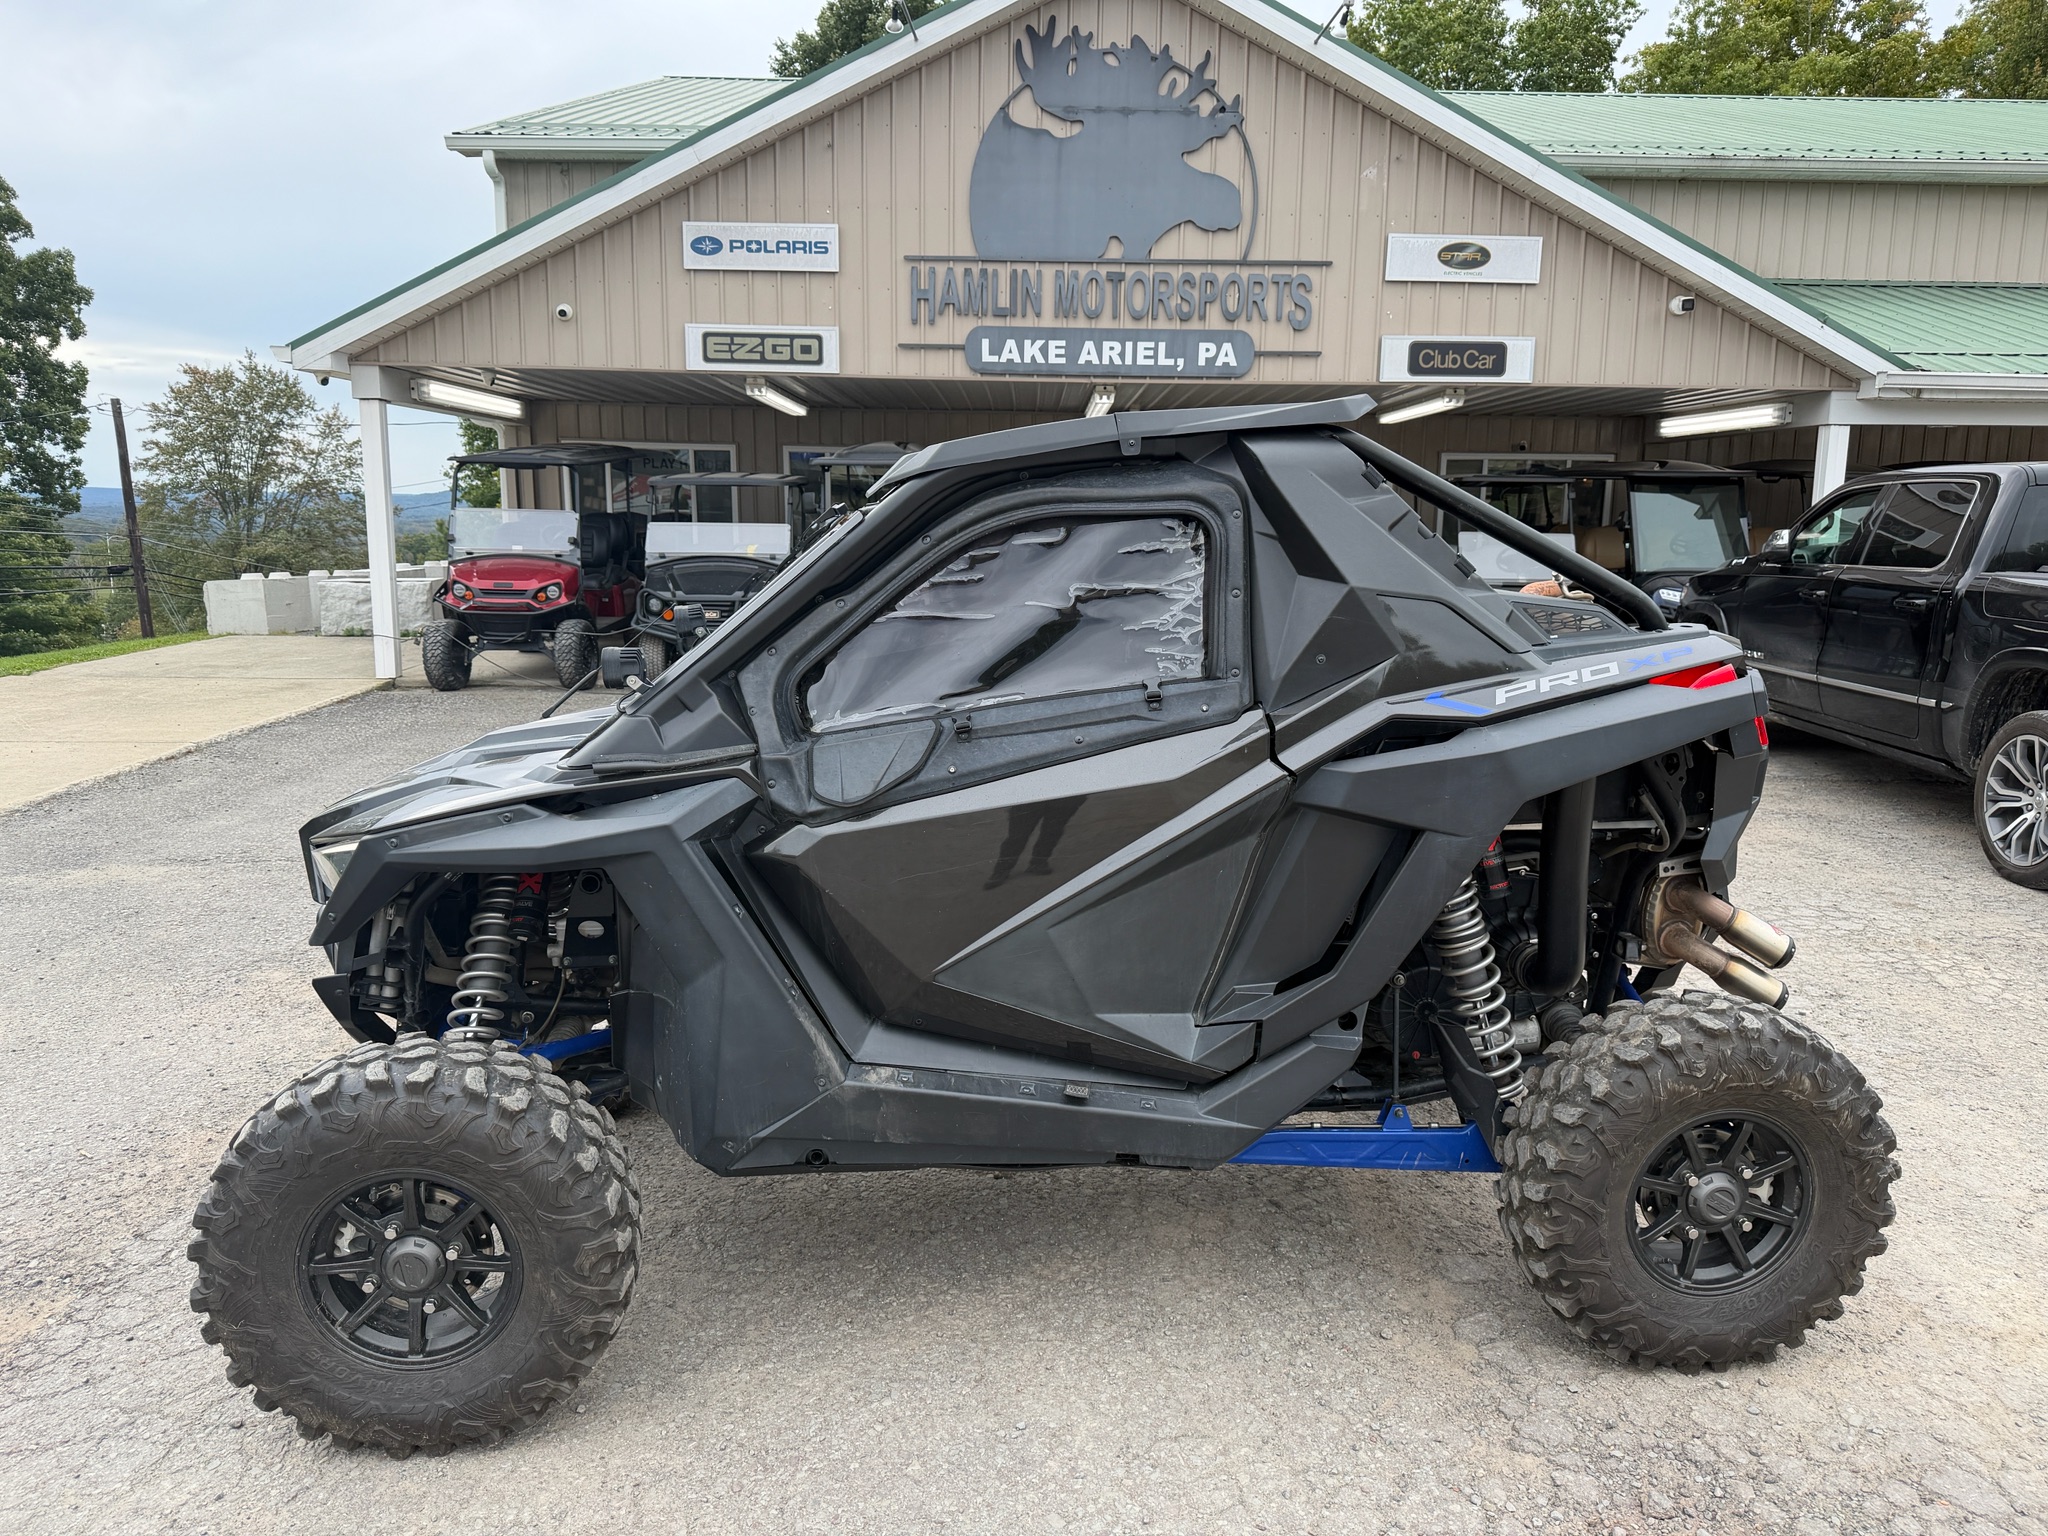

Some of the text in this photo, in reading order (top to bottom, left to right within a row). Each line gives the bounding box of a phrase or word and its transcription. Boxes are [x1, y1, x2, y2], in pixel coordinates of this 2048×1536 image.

[728, 239, 829, 254] POLARIS
[1440, 251, 1482, 261] STAR
[909, 265, 1313, 331] HAMLIN MOTORSPORTS
[706, 336, 822, 361] EZGO
[981, 338, 1238, 371] LAKE ARIEL, PA
[1418, 349, 1497, 369] Club Car
[643, 457, 731, 471] PLAY HRDER
[1495, 645, 1694, 705] PRO XP
